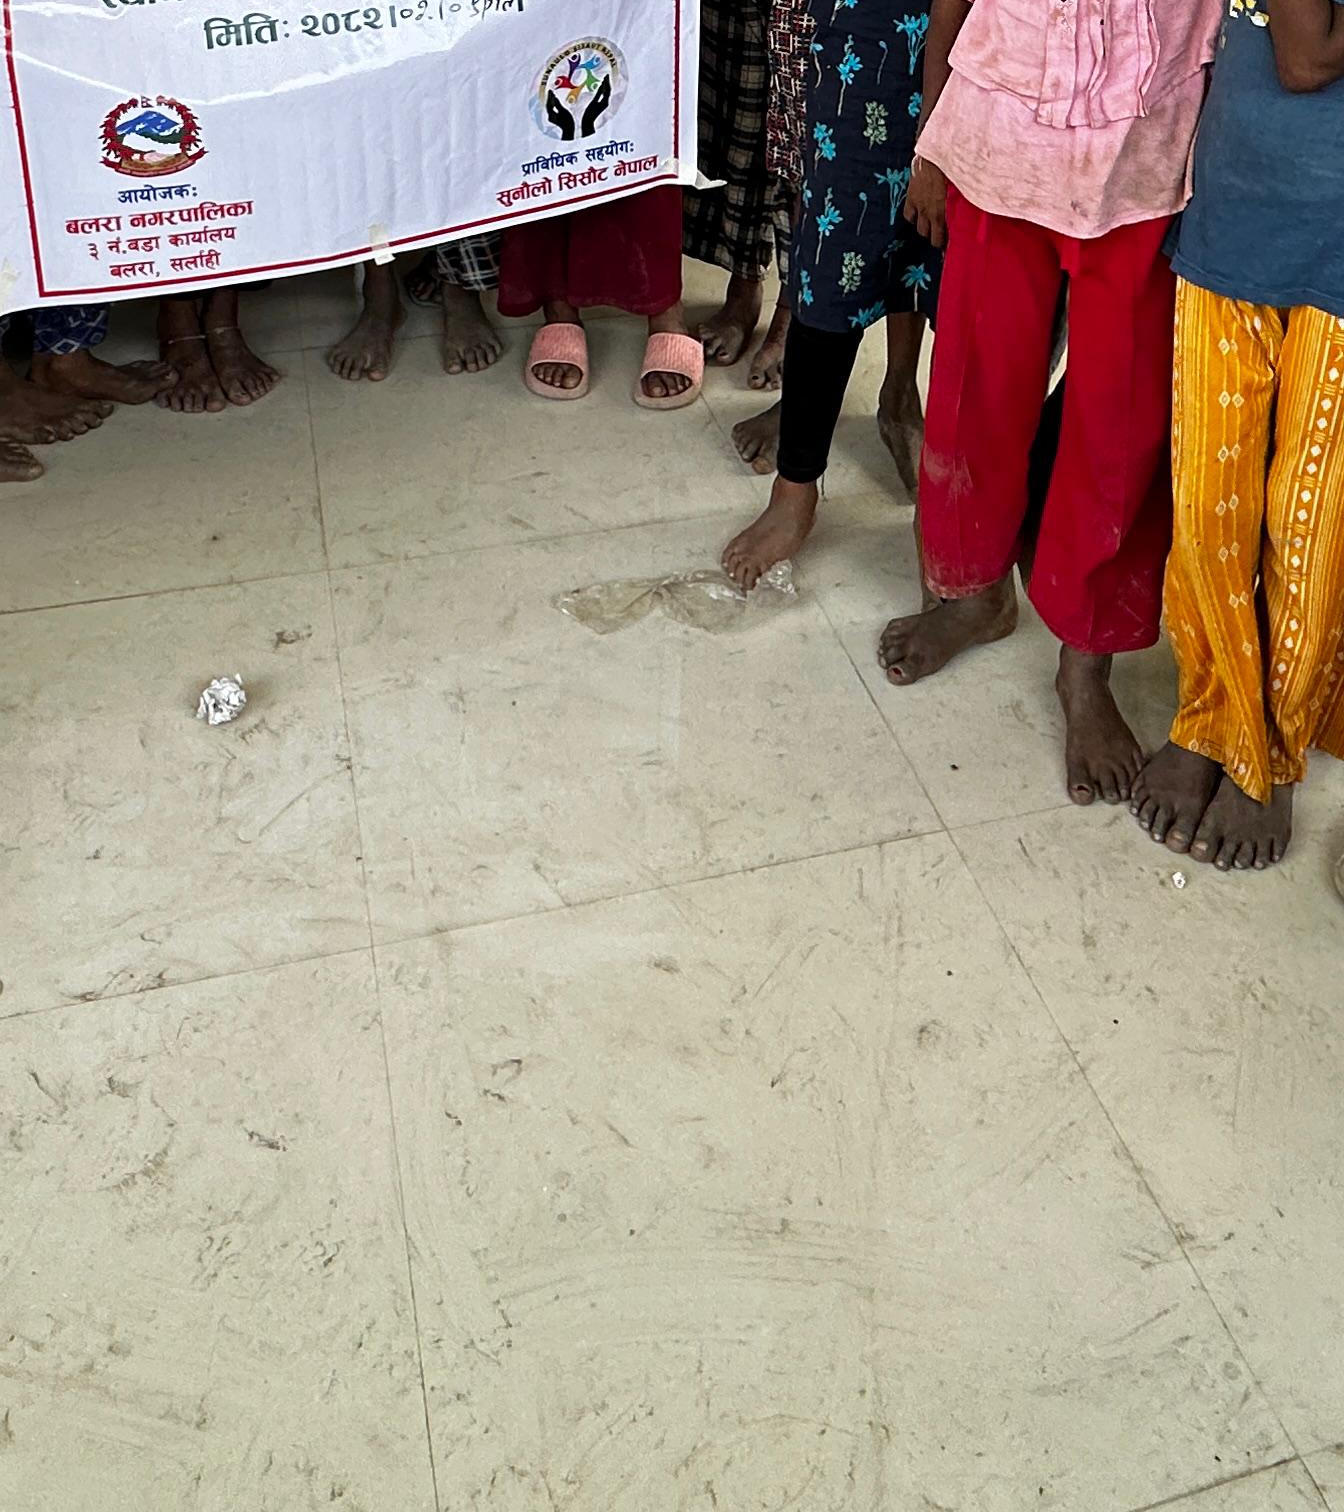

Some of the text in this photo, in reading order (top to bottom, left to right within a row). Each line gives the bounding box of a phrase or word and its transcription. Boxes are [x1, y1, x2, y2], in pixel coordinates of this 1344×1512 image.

[204, 13, 290, 50] मिति:
[117, 184, 198, 205] आयोजक:
[496, 154, 659, 207] सुनौलो सिसौट नेपाल
[65, 200, 255, 235] बलरा नगरपालिका
[168, 226, 238, 248] कार्यालय
[110, 249, 222, 278] बलरा, सर्लाही
